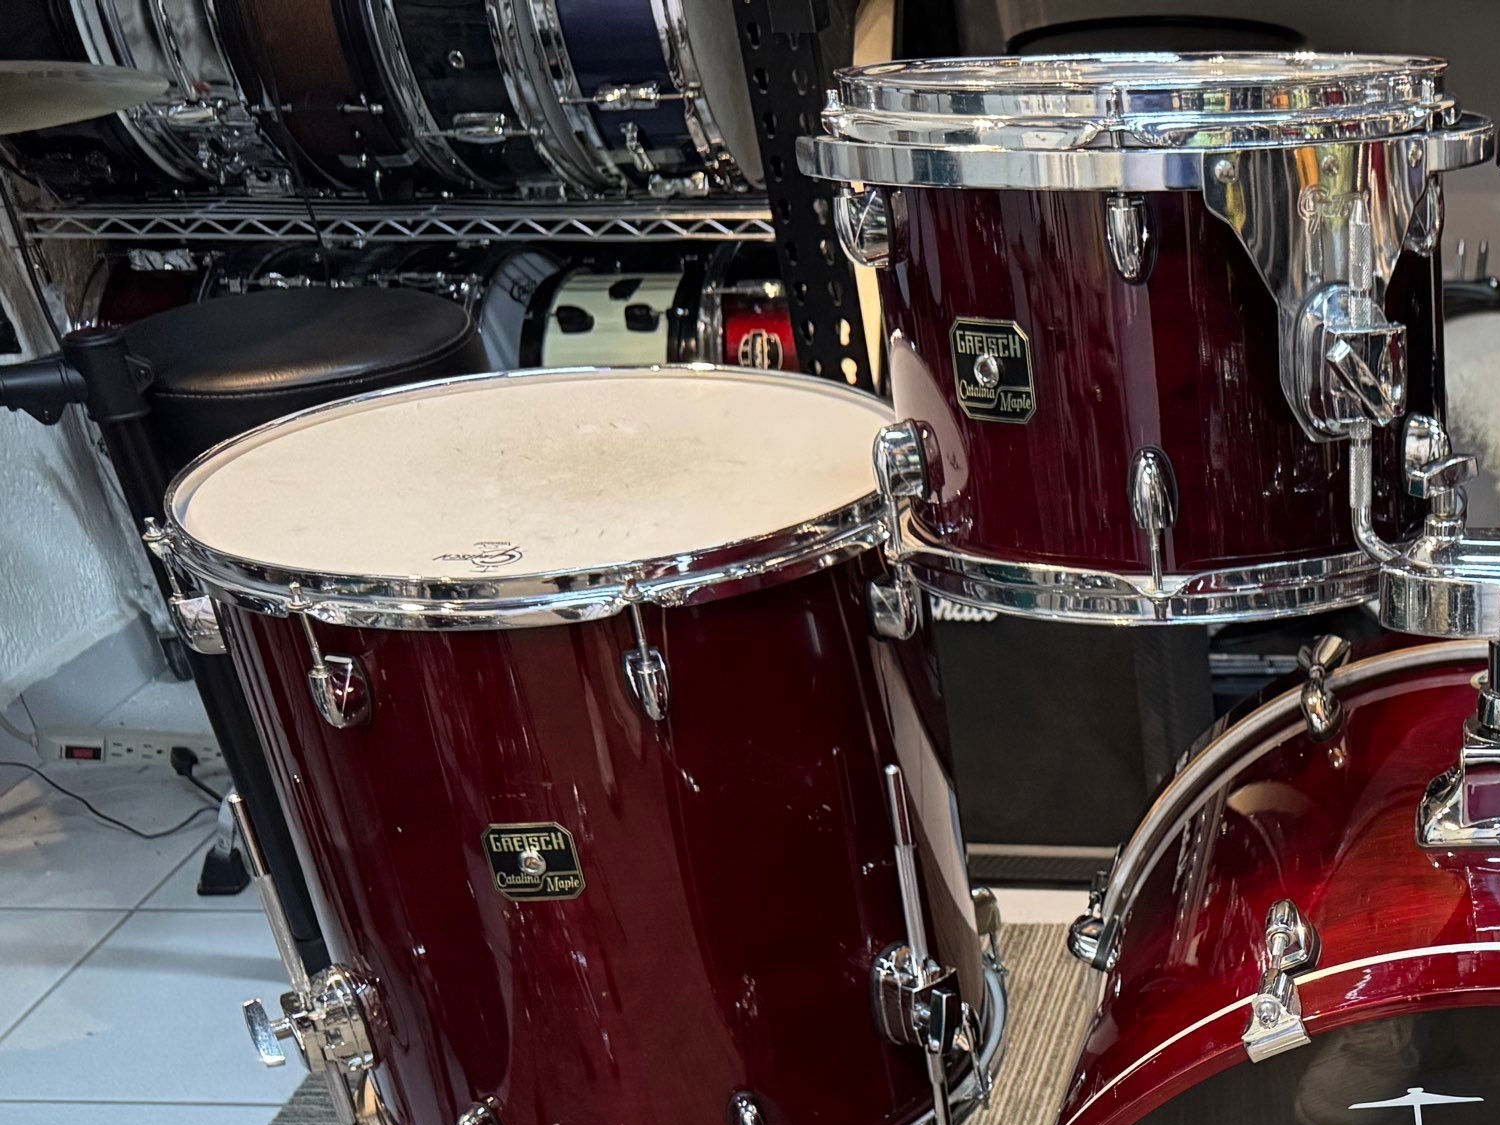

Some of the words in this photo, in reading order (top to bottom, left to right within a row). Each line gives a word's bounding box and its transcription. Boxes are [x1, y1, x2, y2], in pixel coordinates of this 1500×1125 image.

[955, 329, 1022, 358] GRETSCH
[959, 379, 996, 400] Catalina
[1000, 391, 1032, 413] Maple
[489, 832, 566, 853] GRETSCH
[496, 871, 541, 888] Catalina
[545, 876, 581, 893] Maple
